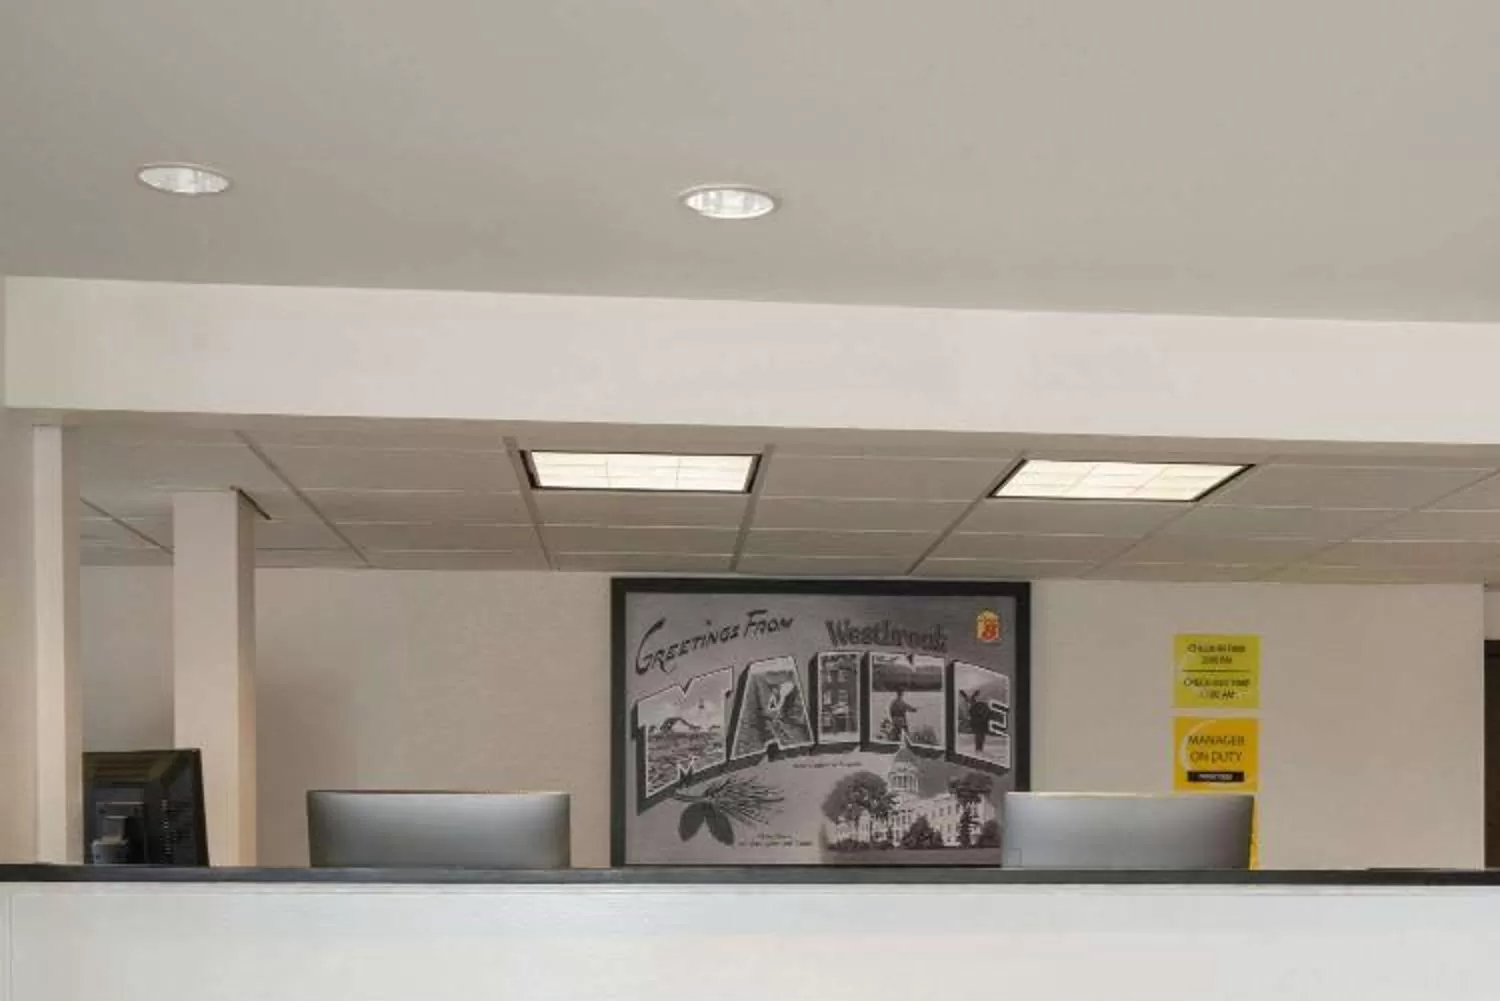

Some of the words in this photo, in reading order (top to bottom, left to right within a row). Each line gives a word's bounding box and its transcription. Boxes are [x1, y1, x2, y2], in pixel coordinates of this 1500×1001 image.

[633, 651, 1011, 812] MAINE
[1187, 735, 1245, 747] MANAGER
[1190, 751, 1209, 763] ON
[1211, 751, 1242, 763] DUTY
